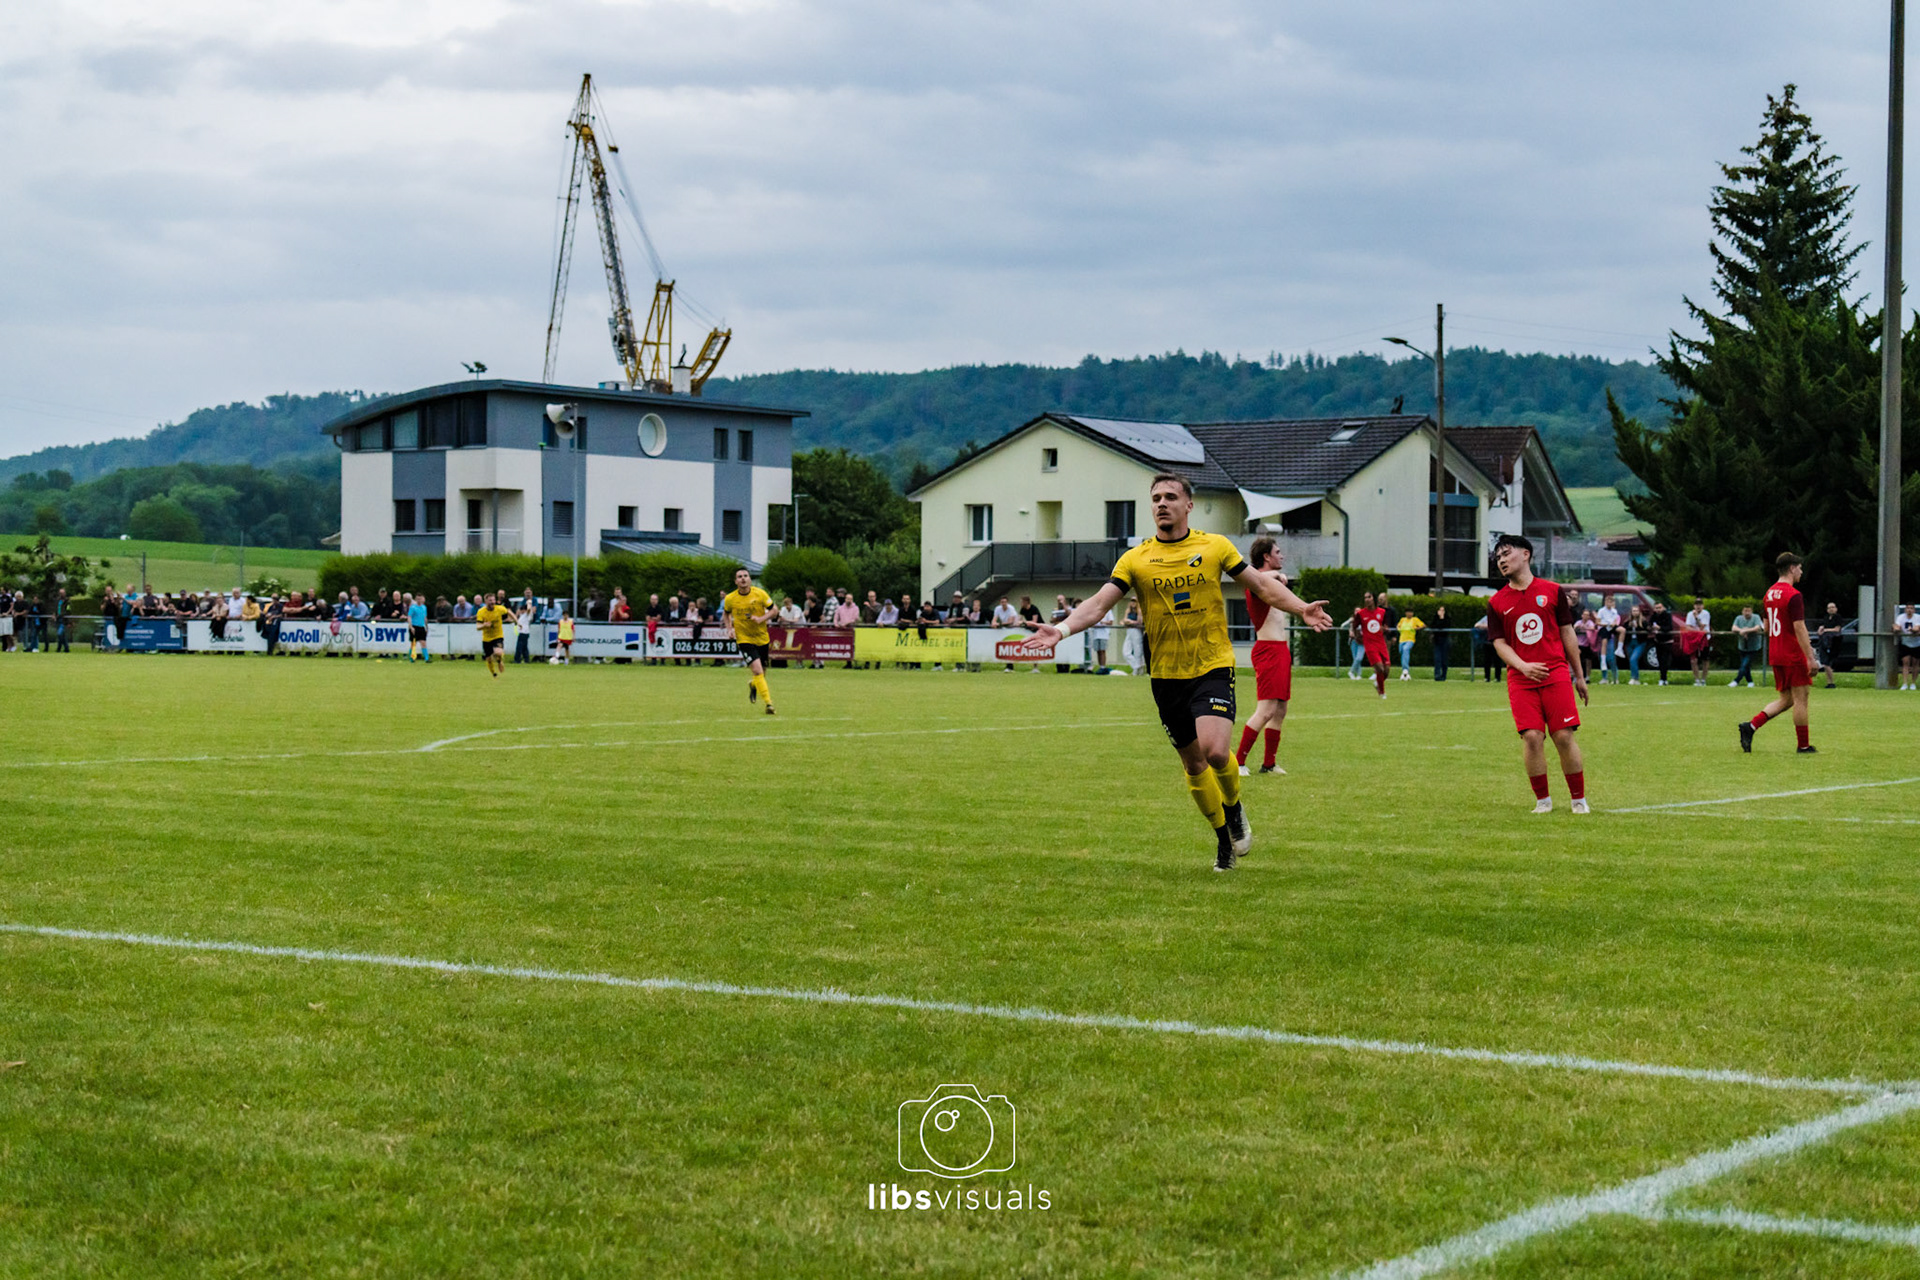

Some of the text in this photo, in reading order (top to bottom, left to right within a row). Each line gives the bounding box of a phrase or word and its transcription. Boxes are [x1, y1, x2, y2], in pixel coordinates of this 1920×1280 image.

[1153, 573, 1207, 590] PADEA
[1766, 606, 1782, 638] 16
[279, 628, 355, 648] onRoll hydro
[375, 627, 407, 642] BWT
[675, 641, 692, 652] 026
[694, 641, 711, 652] 422
[713, 641, 724, 652] 19
[726, 641, 737, 653] 18
[998, 645, 1053, 657] MICARNA
